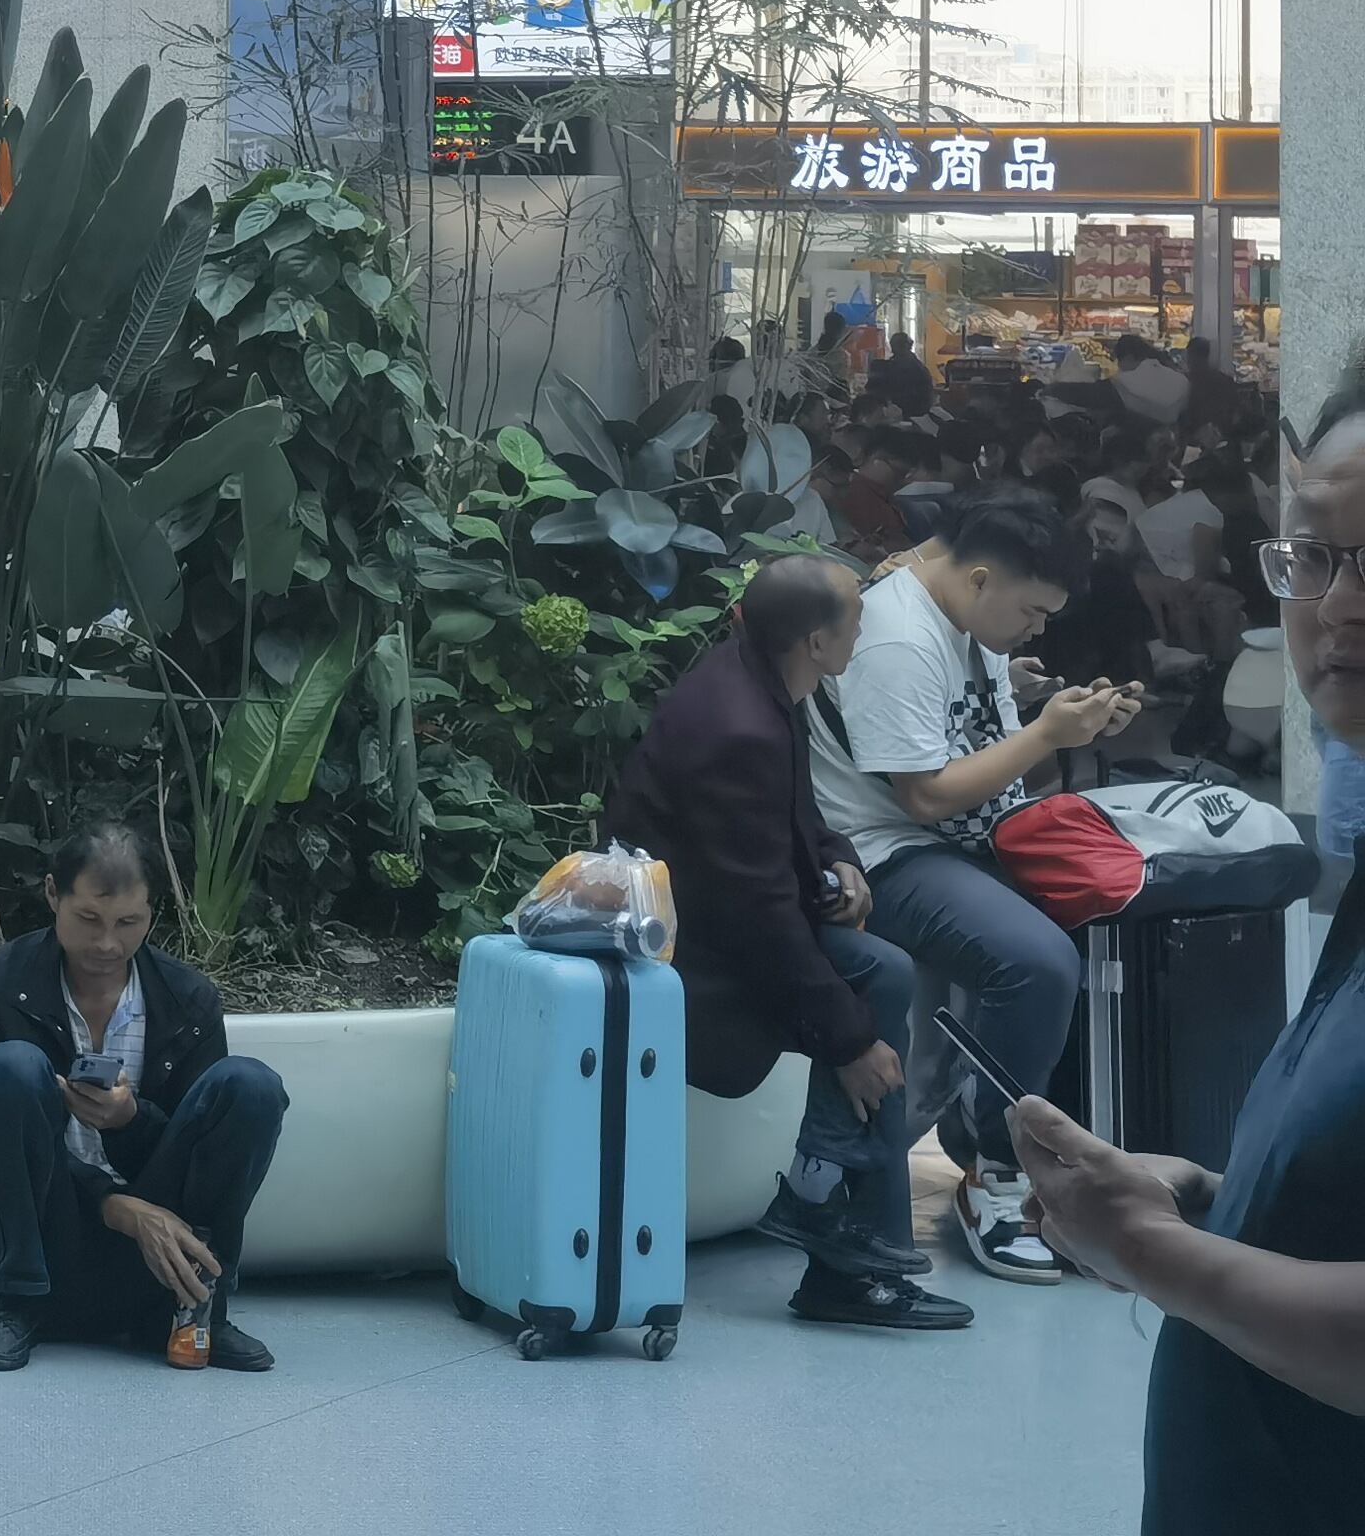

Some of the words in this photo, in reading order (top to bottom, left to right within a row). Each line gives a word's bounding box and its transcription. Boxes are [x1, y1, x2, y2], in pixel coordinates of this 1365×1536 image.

[516, 119, 577, 154] 4A
[790, 133, 1056, 193] 旅游商品
[1193, 791, 1239, 817] NIKE
